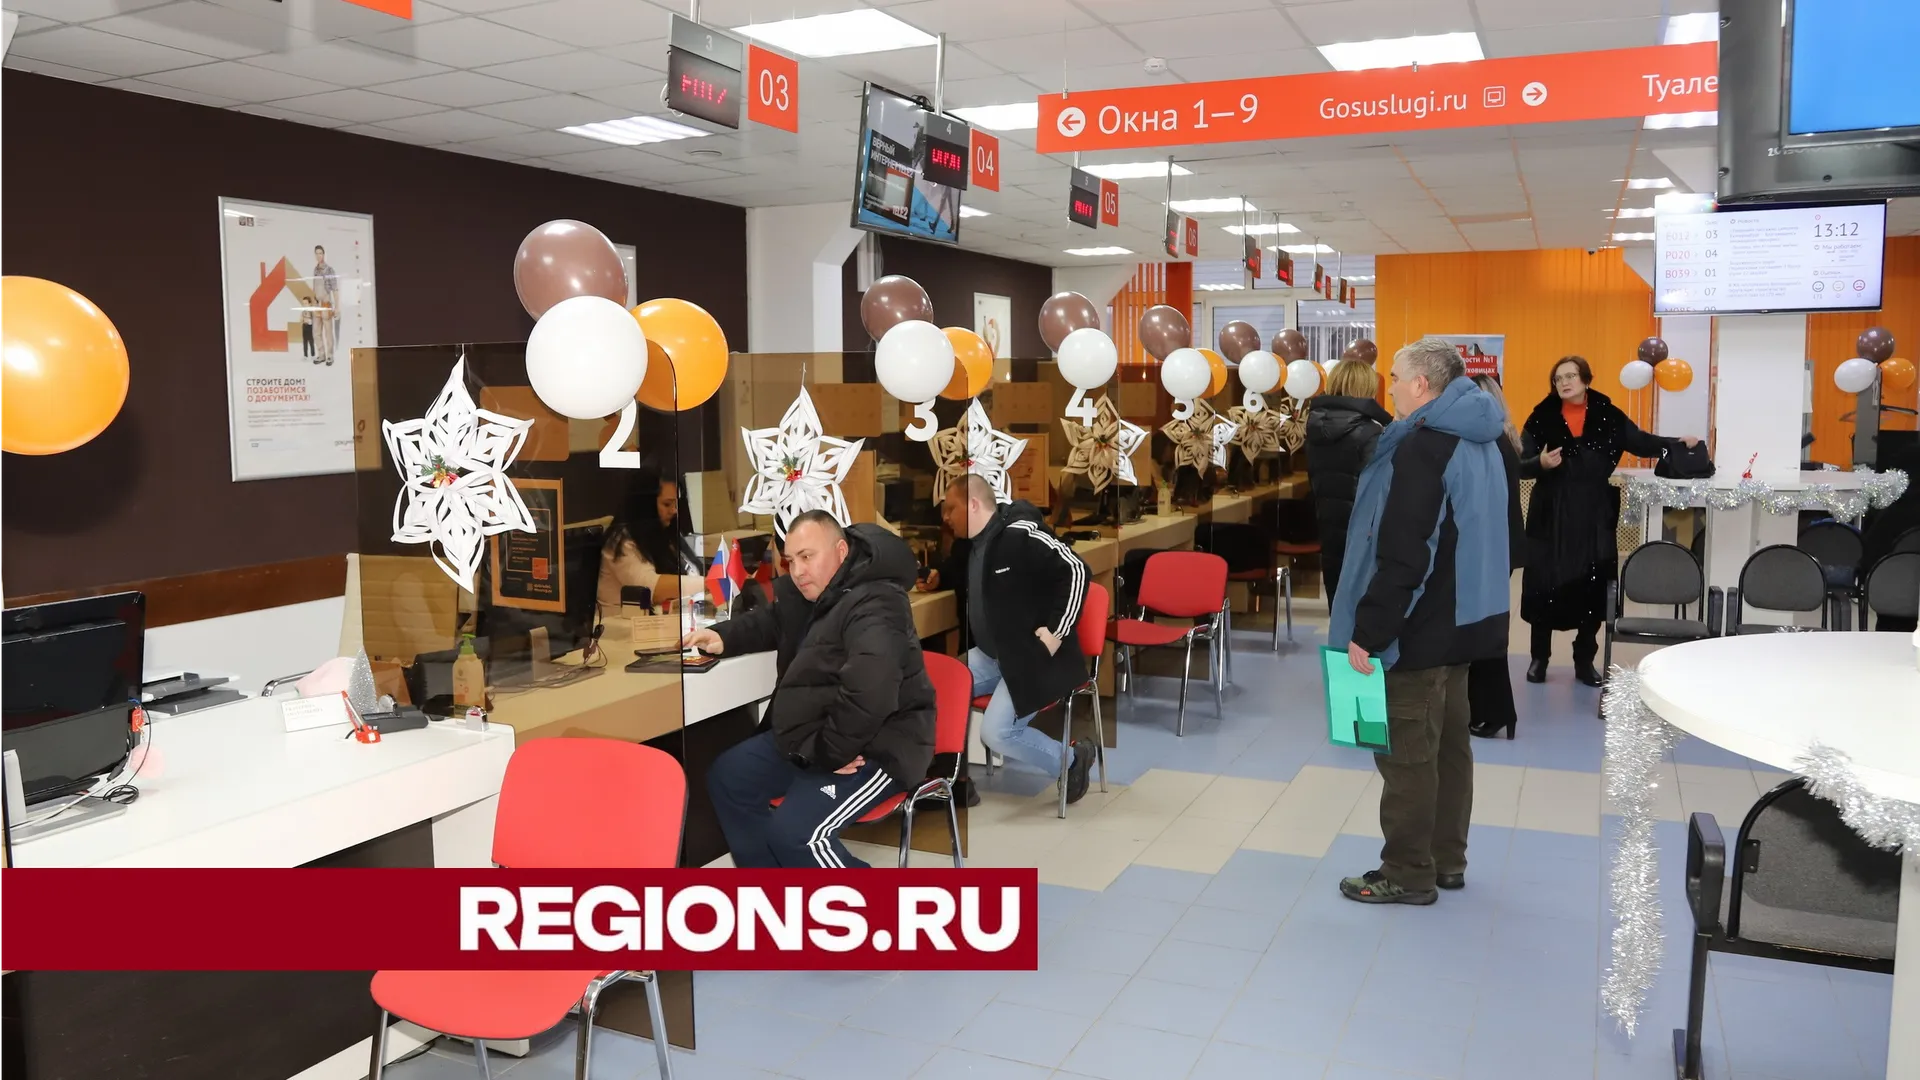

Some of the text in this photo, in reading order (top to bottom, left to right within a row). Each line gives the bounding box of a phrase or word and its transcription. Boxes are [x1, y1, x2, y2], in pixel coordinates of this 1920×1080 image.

[706, 35, 712, 51] 3
[760, 69, 789, 111] 03
[1642, 73, 1718, 102] Туале
[1319, 90, 1467, 120] Gosuslugi.ru
[946, 123, 952, 135] 4
[1098, 105, 1177, 134] Окна
[872, 136, 895, 156] ВЕРНЫЙ
[976, 146, 994, 176] 04
[1084, 176, 1088, 186] 5
[892, 205, 908, 219] TELE2
[1105, 192, 1116, 215] 05
[1188, 225, 1196, 247] 06
[1705, 230, 1718, 239] 03
[1814, 222, 1859, 238] 13:12
[1705, 249, 1718, 258] 04
[1704, 268, 1717, 278] 01
[1704, 288, 1717, 296] 07
[284, 378, 306, 386] ДОМ?
[255, 394, 311, 403] ДОКУМЕНТАХ!
[1065, 388, 1098, 427] 4
[1243, 388, 1264, 413] 6
[904, 398, 938, 442] 3
[599, 398, 640, 468] 2
